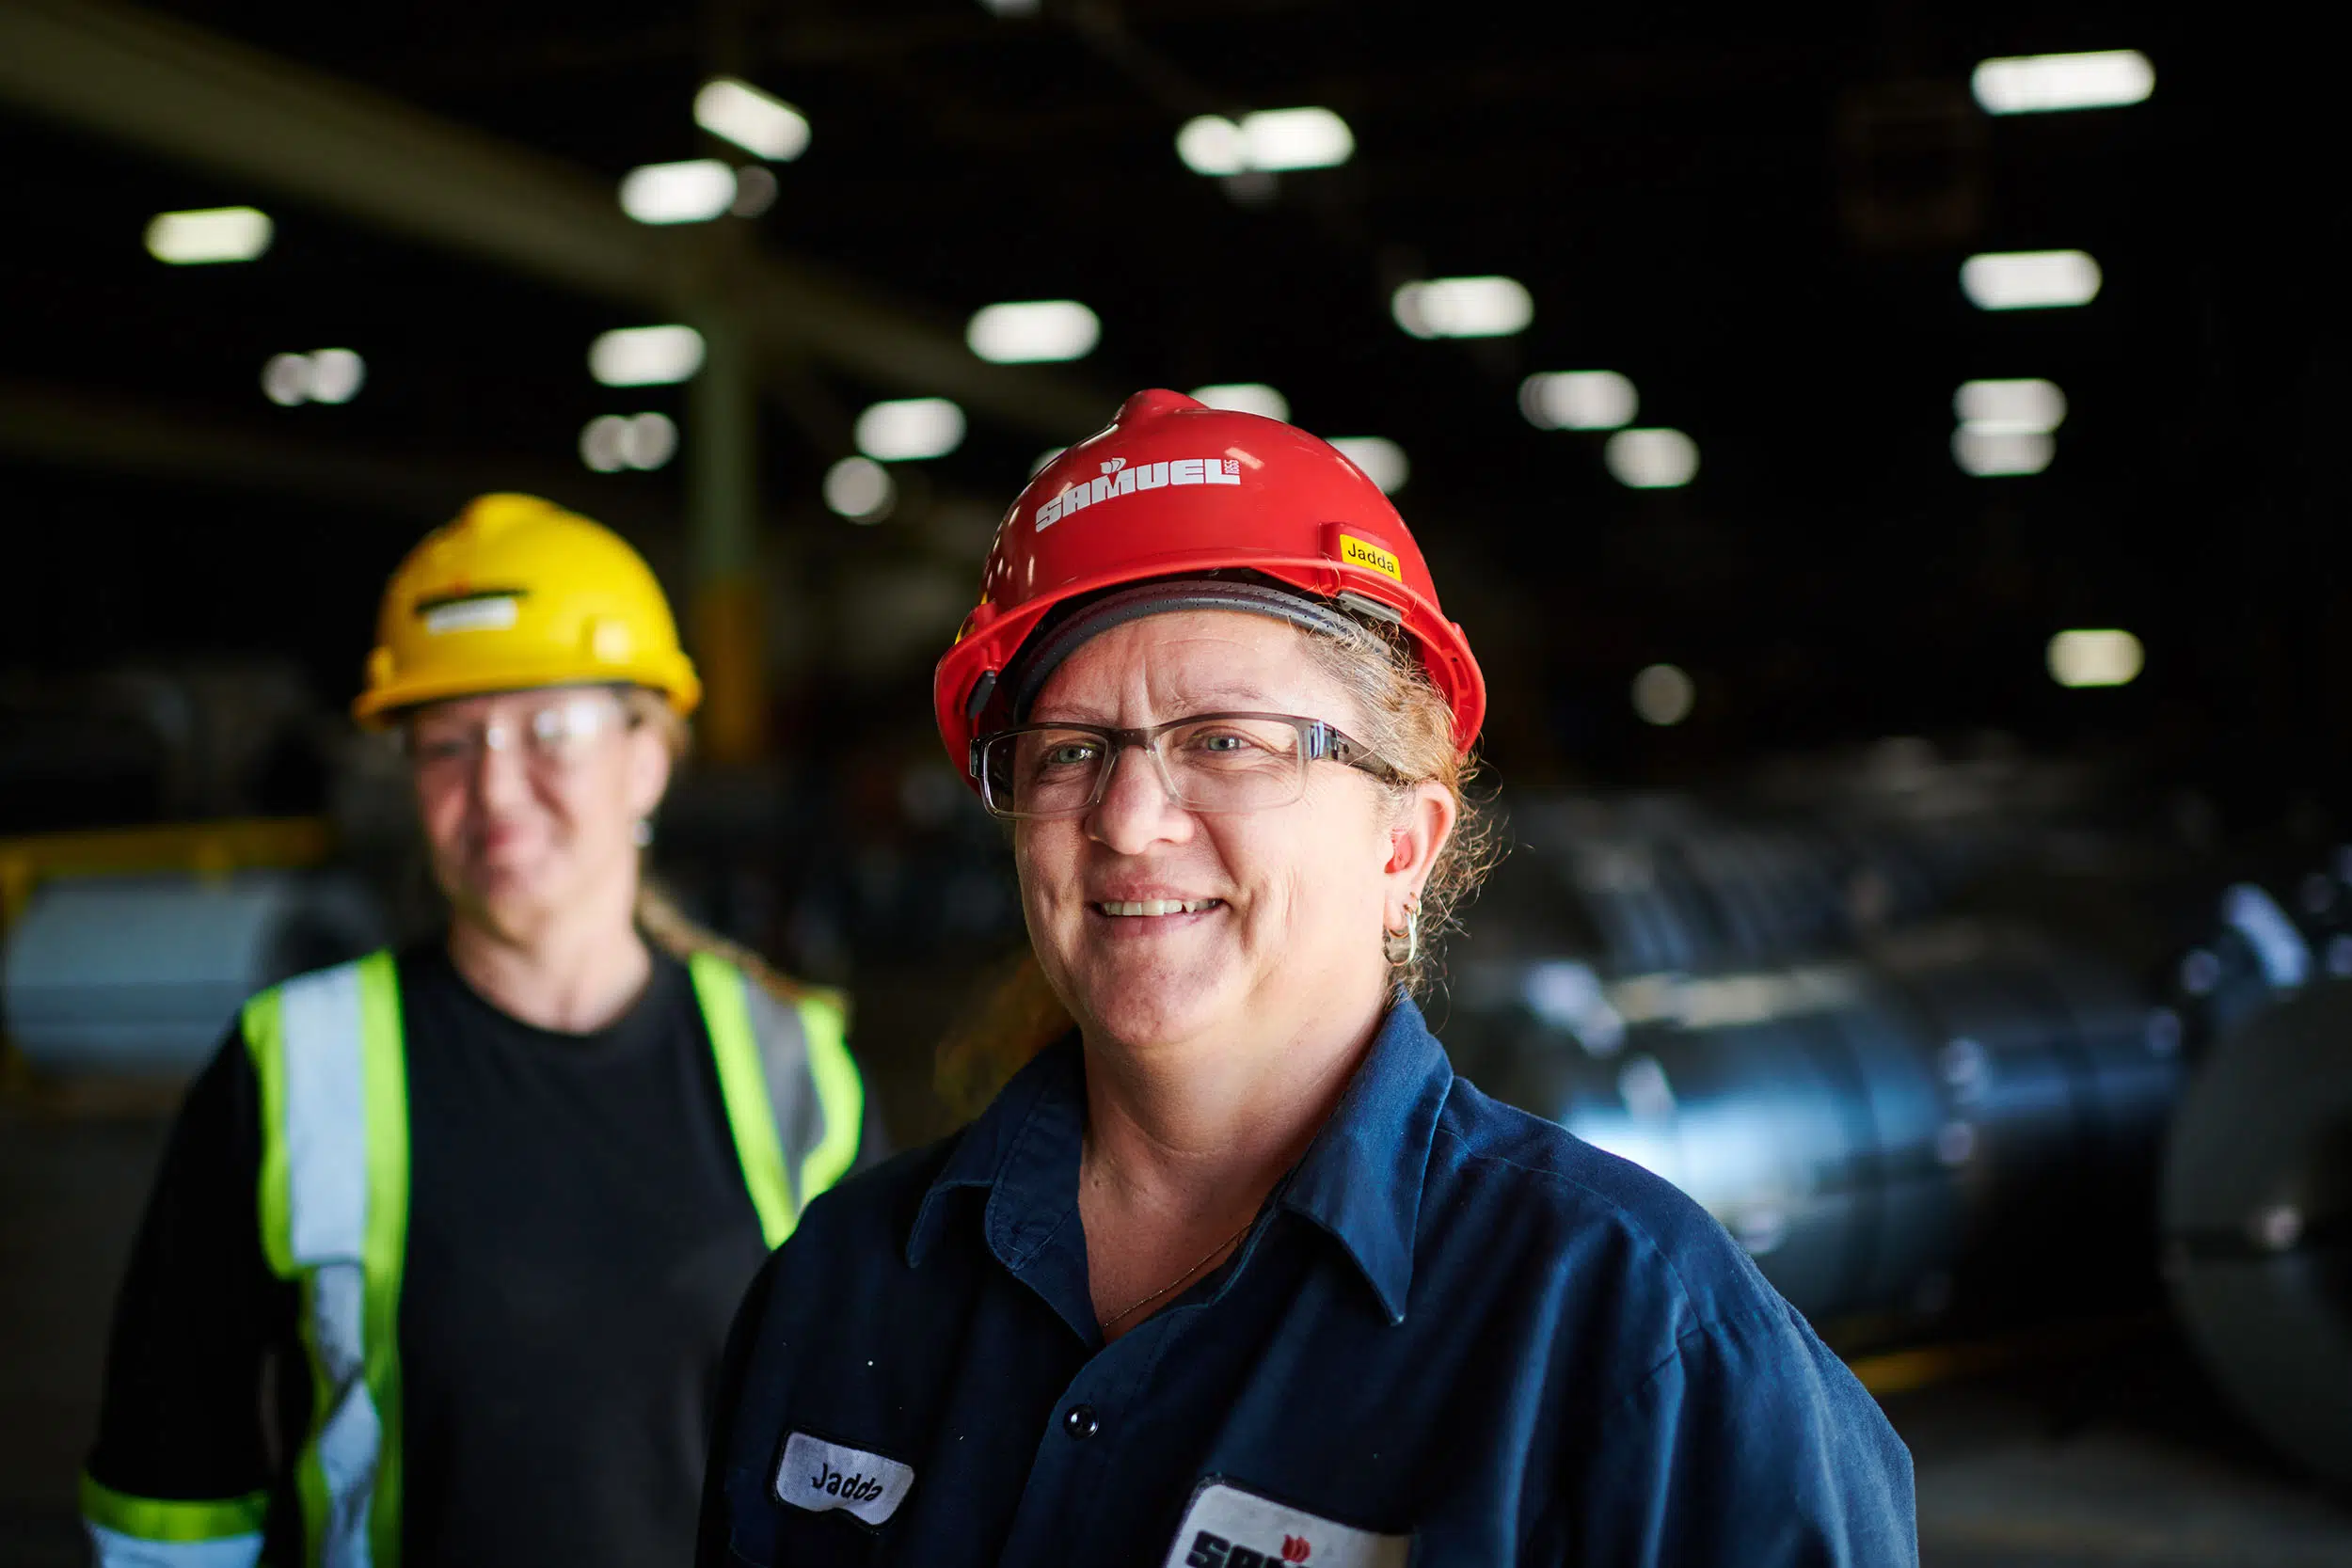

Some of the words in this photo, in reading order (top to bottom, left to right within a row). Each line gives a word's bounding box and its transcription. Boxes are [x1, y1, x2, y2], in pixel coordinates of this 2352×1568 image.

[1036, 458, 1241, 532] SAMUEL
[1347, 543, 1395, 574] Jadda
[811, 1462, 884, 1502] Jadda
